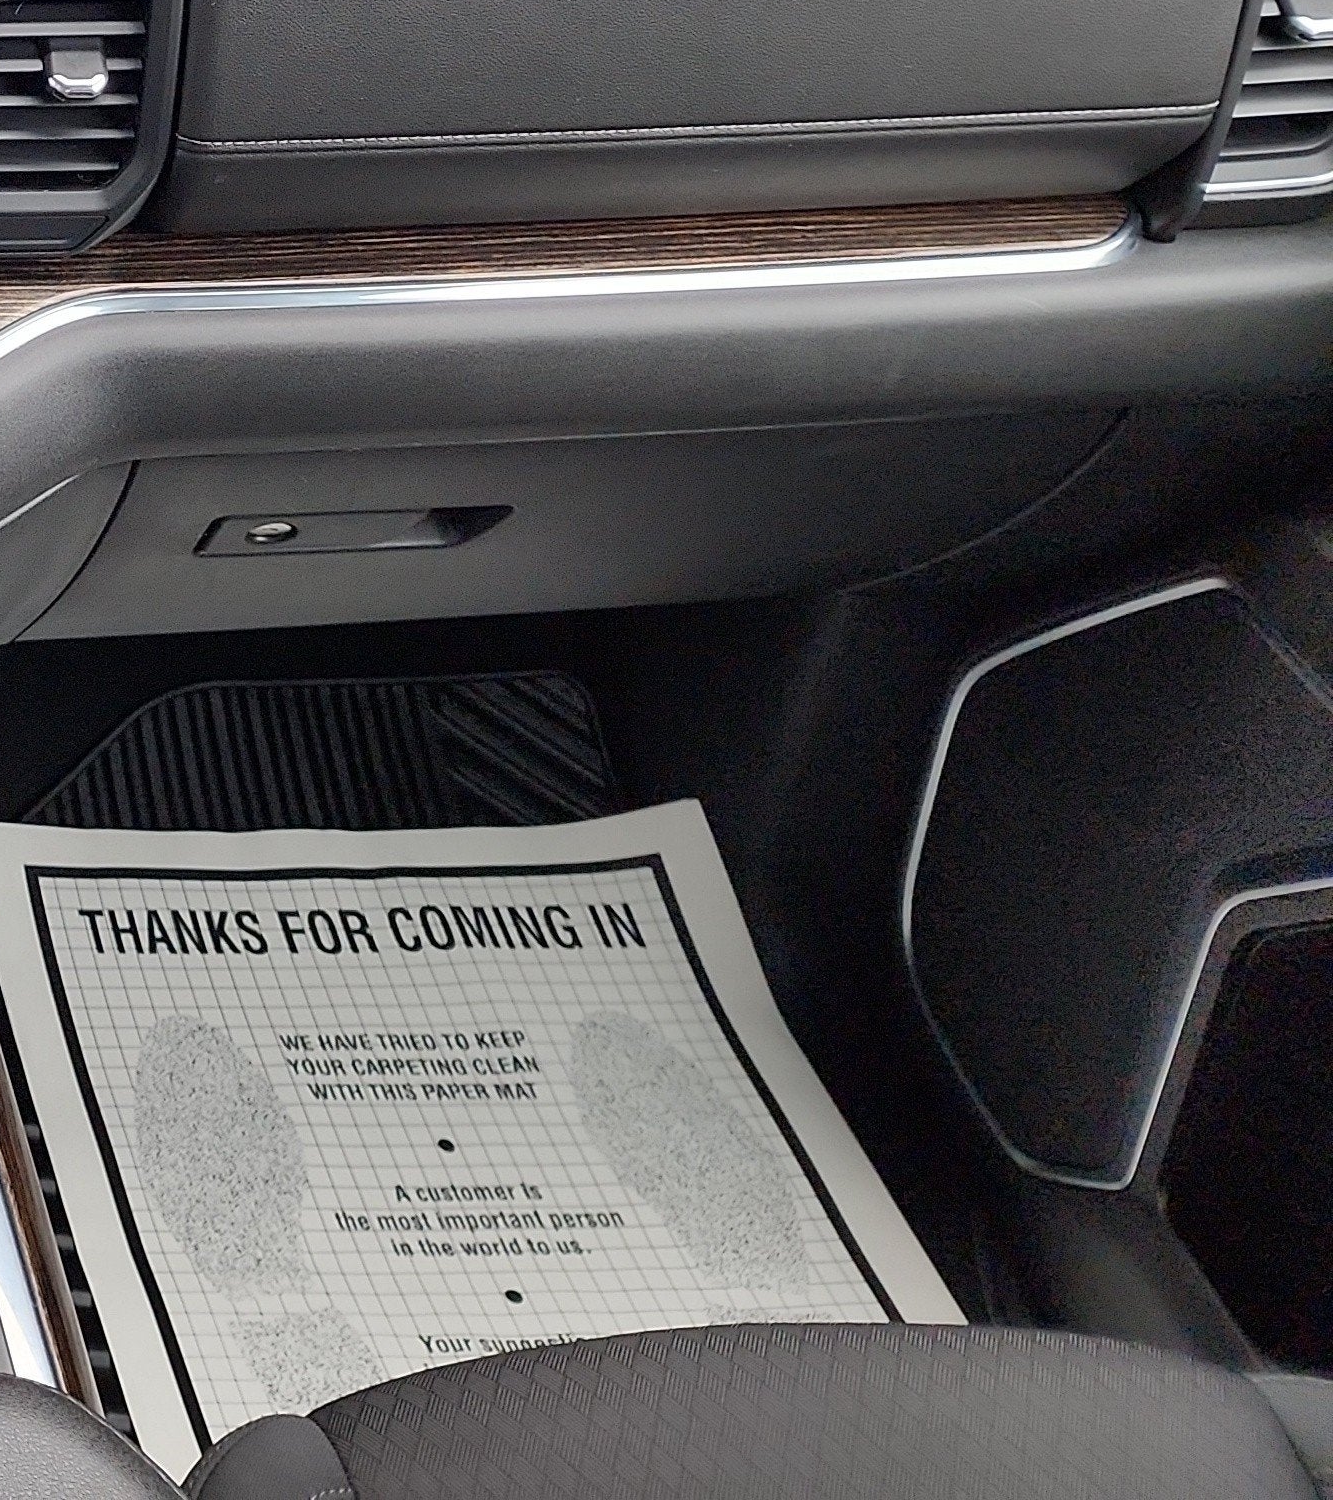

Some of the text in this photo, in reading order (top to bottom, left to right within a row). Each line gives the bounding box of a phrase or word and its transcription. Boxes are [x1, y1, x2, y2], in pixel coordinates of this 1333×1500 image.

[78, 903, 648, 955] THANKS FOR COMING IN
[279, 1030, 525, 1051] WE HAVE TRIED TO KEEP
[286, 1055, 540, 1077] YOUR CARPETING CLEAN
[307, 1082, 537, 1101] WITH THIS PAPER MAT
[394, 1181, 544, 1203] A customer is
[335, 1209, 626, 1234] the most important person
[391, 1237, 593, 1257] in the world to us.
[418, 1333, 471, 1354] Your
